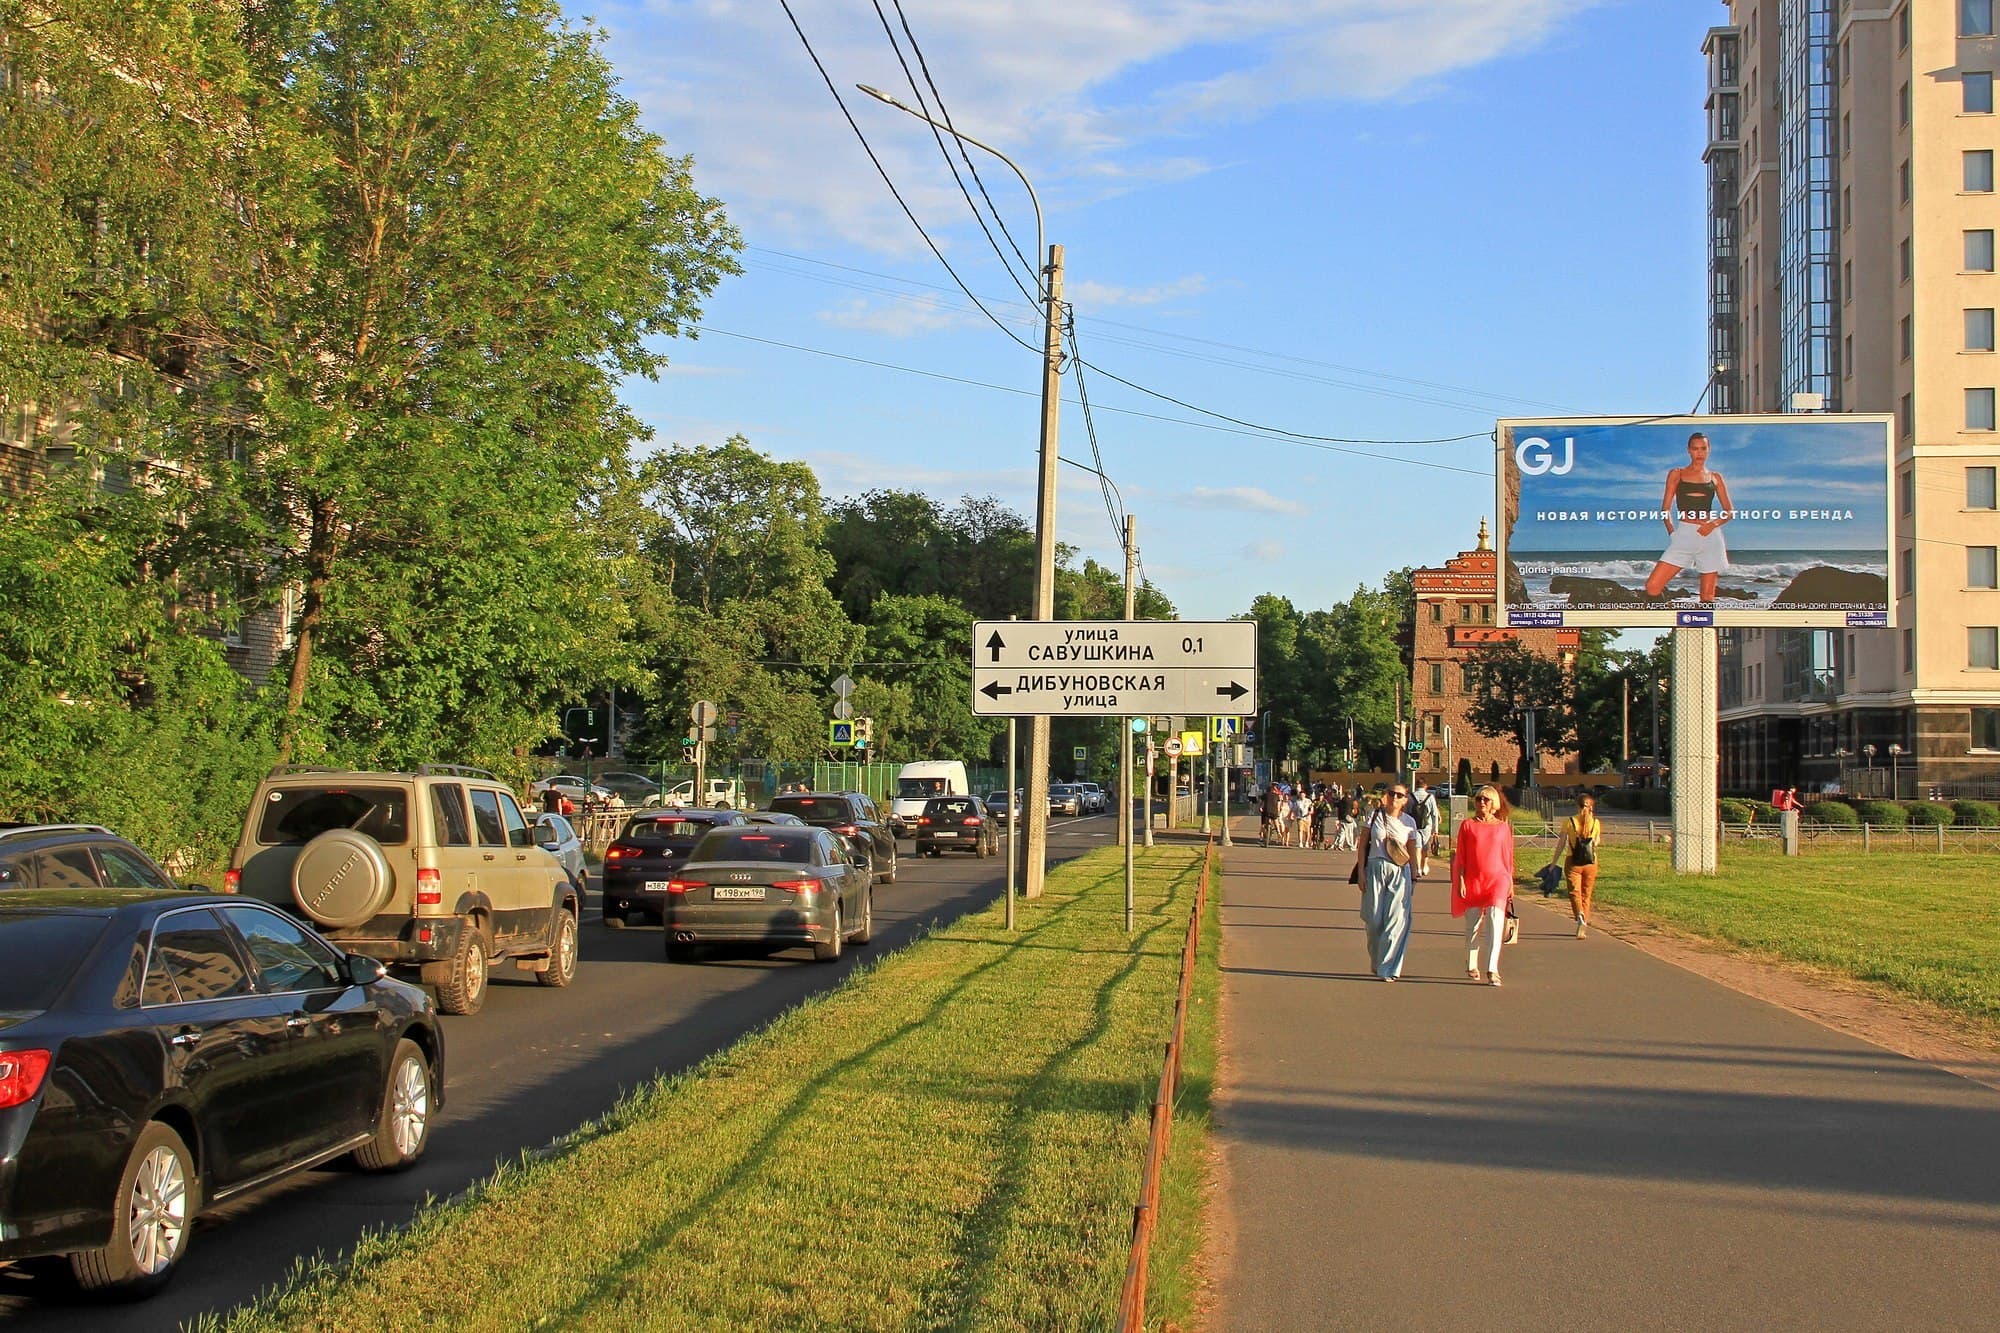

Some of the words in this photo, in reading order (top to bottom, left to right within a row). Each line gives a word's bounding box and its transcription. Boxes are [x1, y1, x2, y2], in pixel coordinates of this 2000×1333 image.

[1515, 437, 1574, 476] GJ
[1537, 511, 1589, 521] НОВАЯ
[1596, 510, 1670, 521] ИСТОРИЯ
[1677, 509, 1782, 520] ИЗВЕСТНОГО
[1789, 509, 1854, 521] БРЕНДА
[1518, 564, 1592, 576] gloria-jeans.ru
[1064, 628, 1119, 643] улица
[1028, 645, 1155, 661] САВУШКИНА
[1182, 637, 1204, 655] 0,1
[1015, 675, 1166, 693] ДИБУНОВСКАЯ
[1063, 694, 1118, 709] улица
[311, 852, 360, 908] PATRIOT
